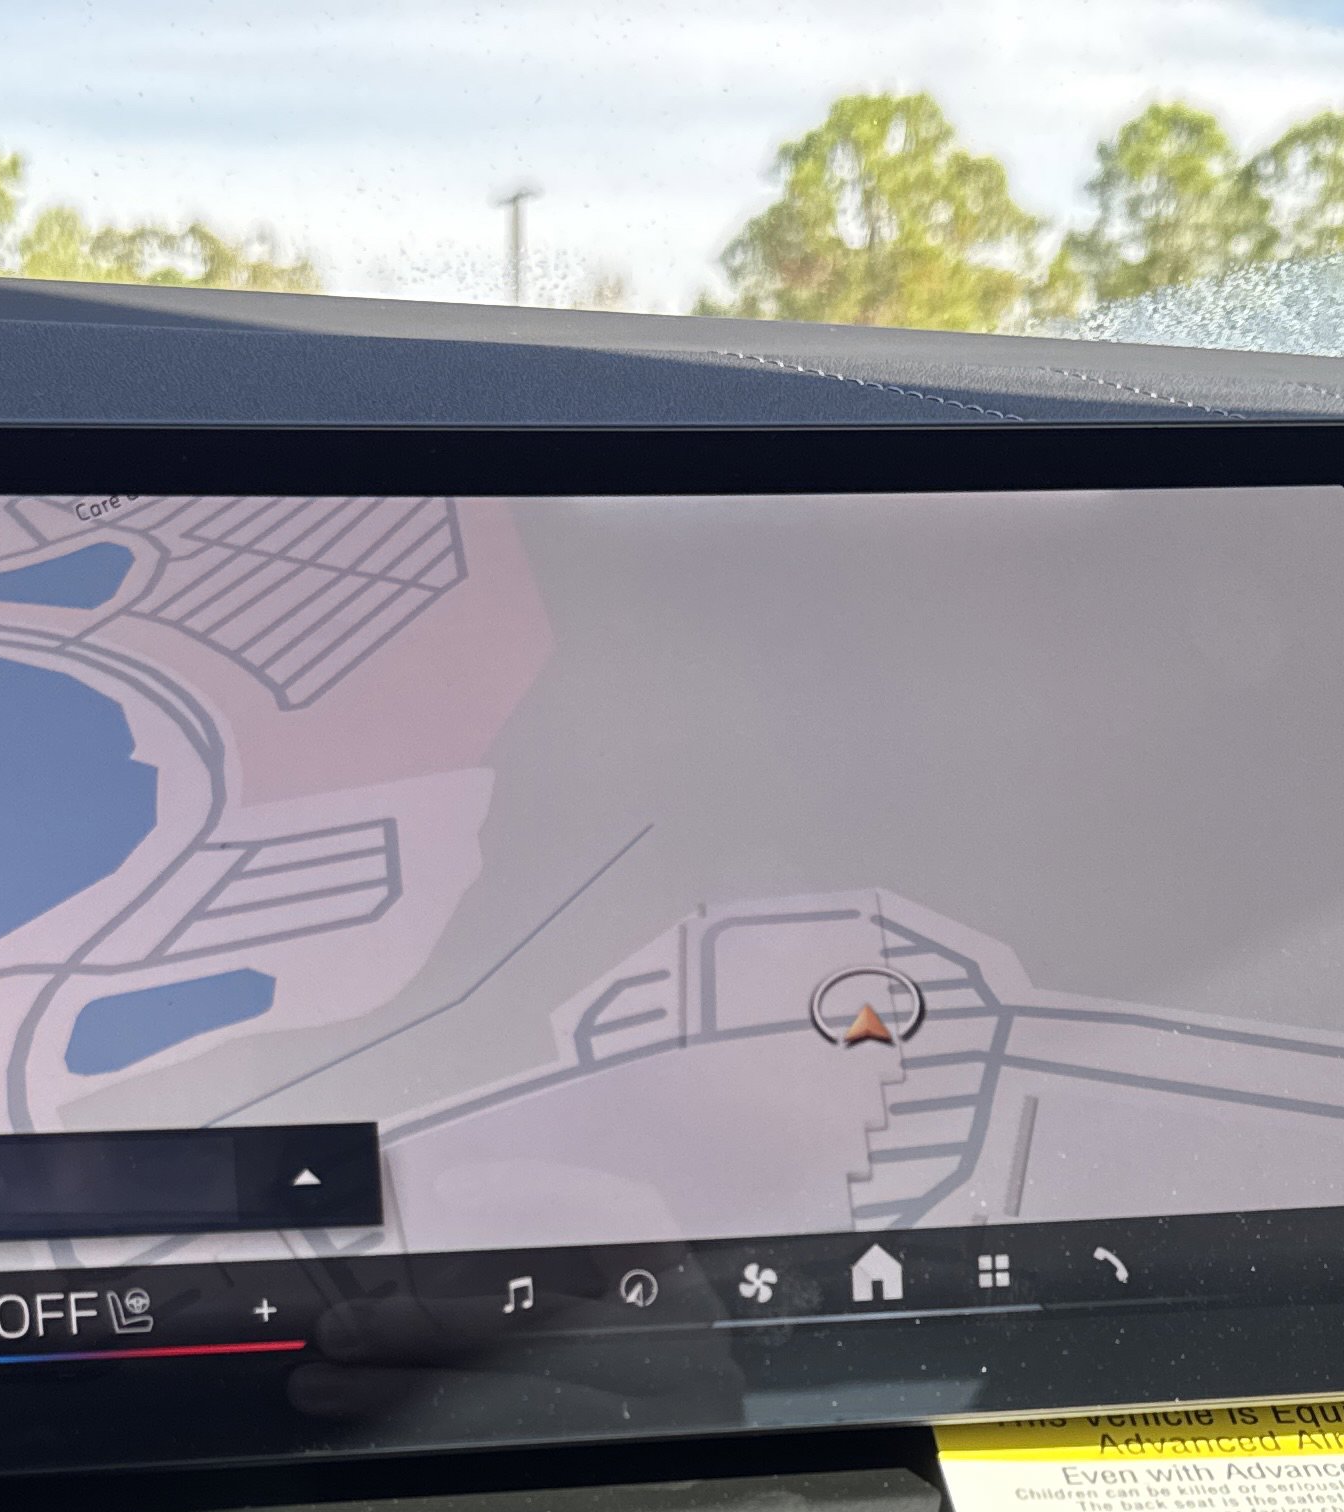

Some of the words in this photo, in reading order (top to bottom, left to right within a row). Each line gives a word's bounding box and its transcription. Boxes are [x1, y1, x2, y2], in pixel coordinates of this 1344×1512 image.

[75, 495, 121, 521] Care
[1099, 1429, 1281, 1455] Advanced
[1297, 1429, 1344, 1450] Air
[1062, 1466, 1138, 1485] Even
[1146, 1463, 1215, 1482] with
